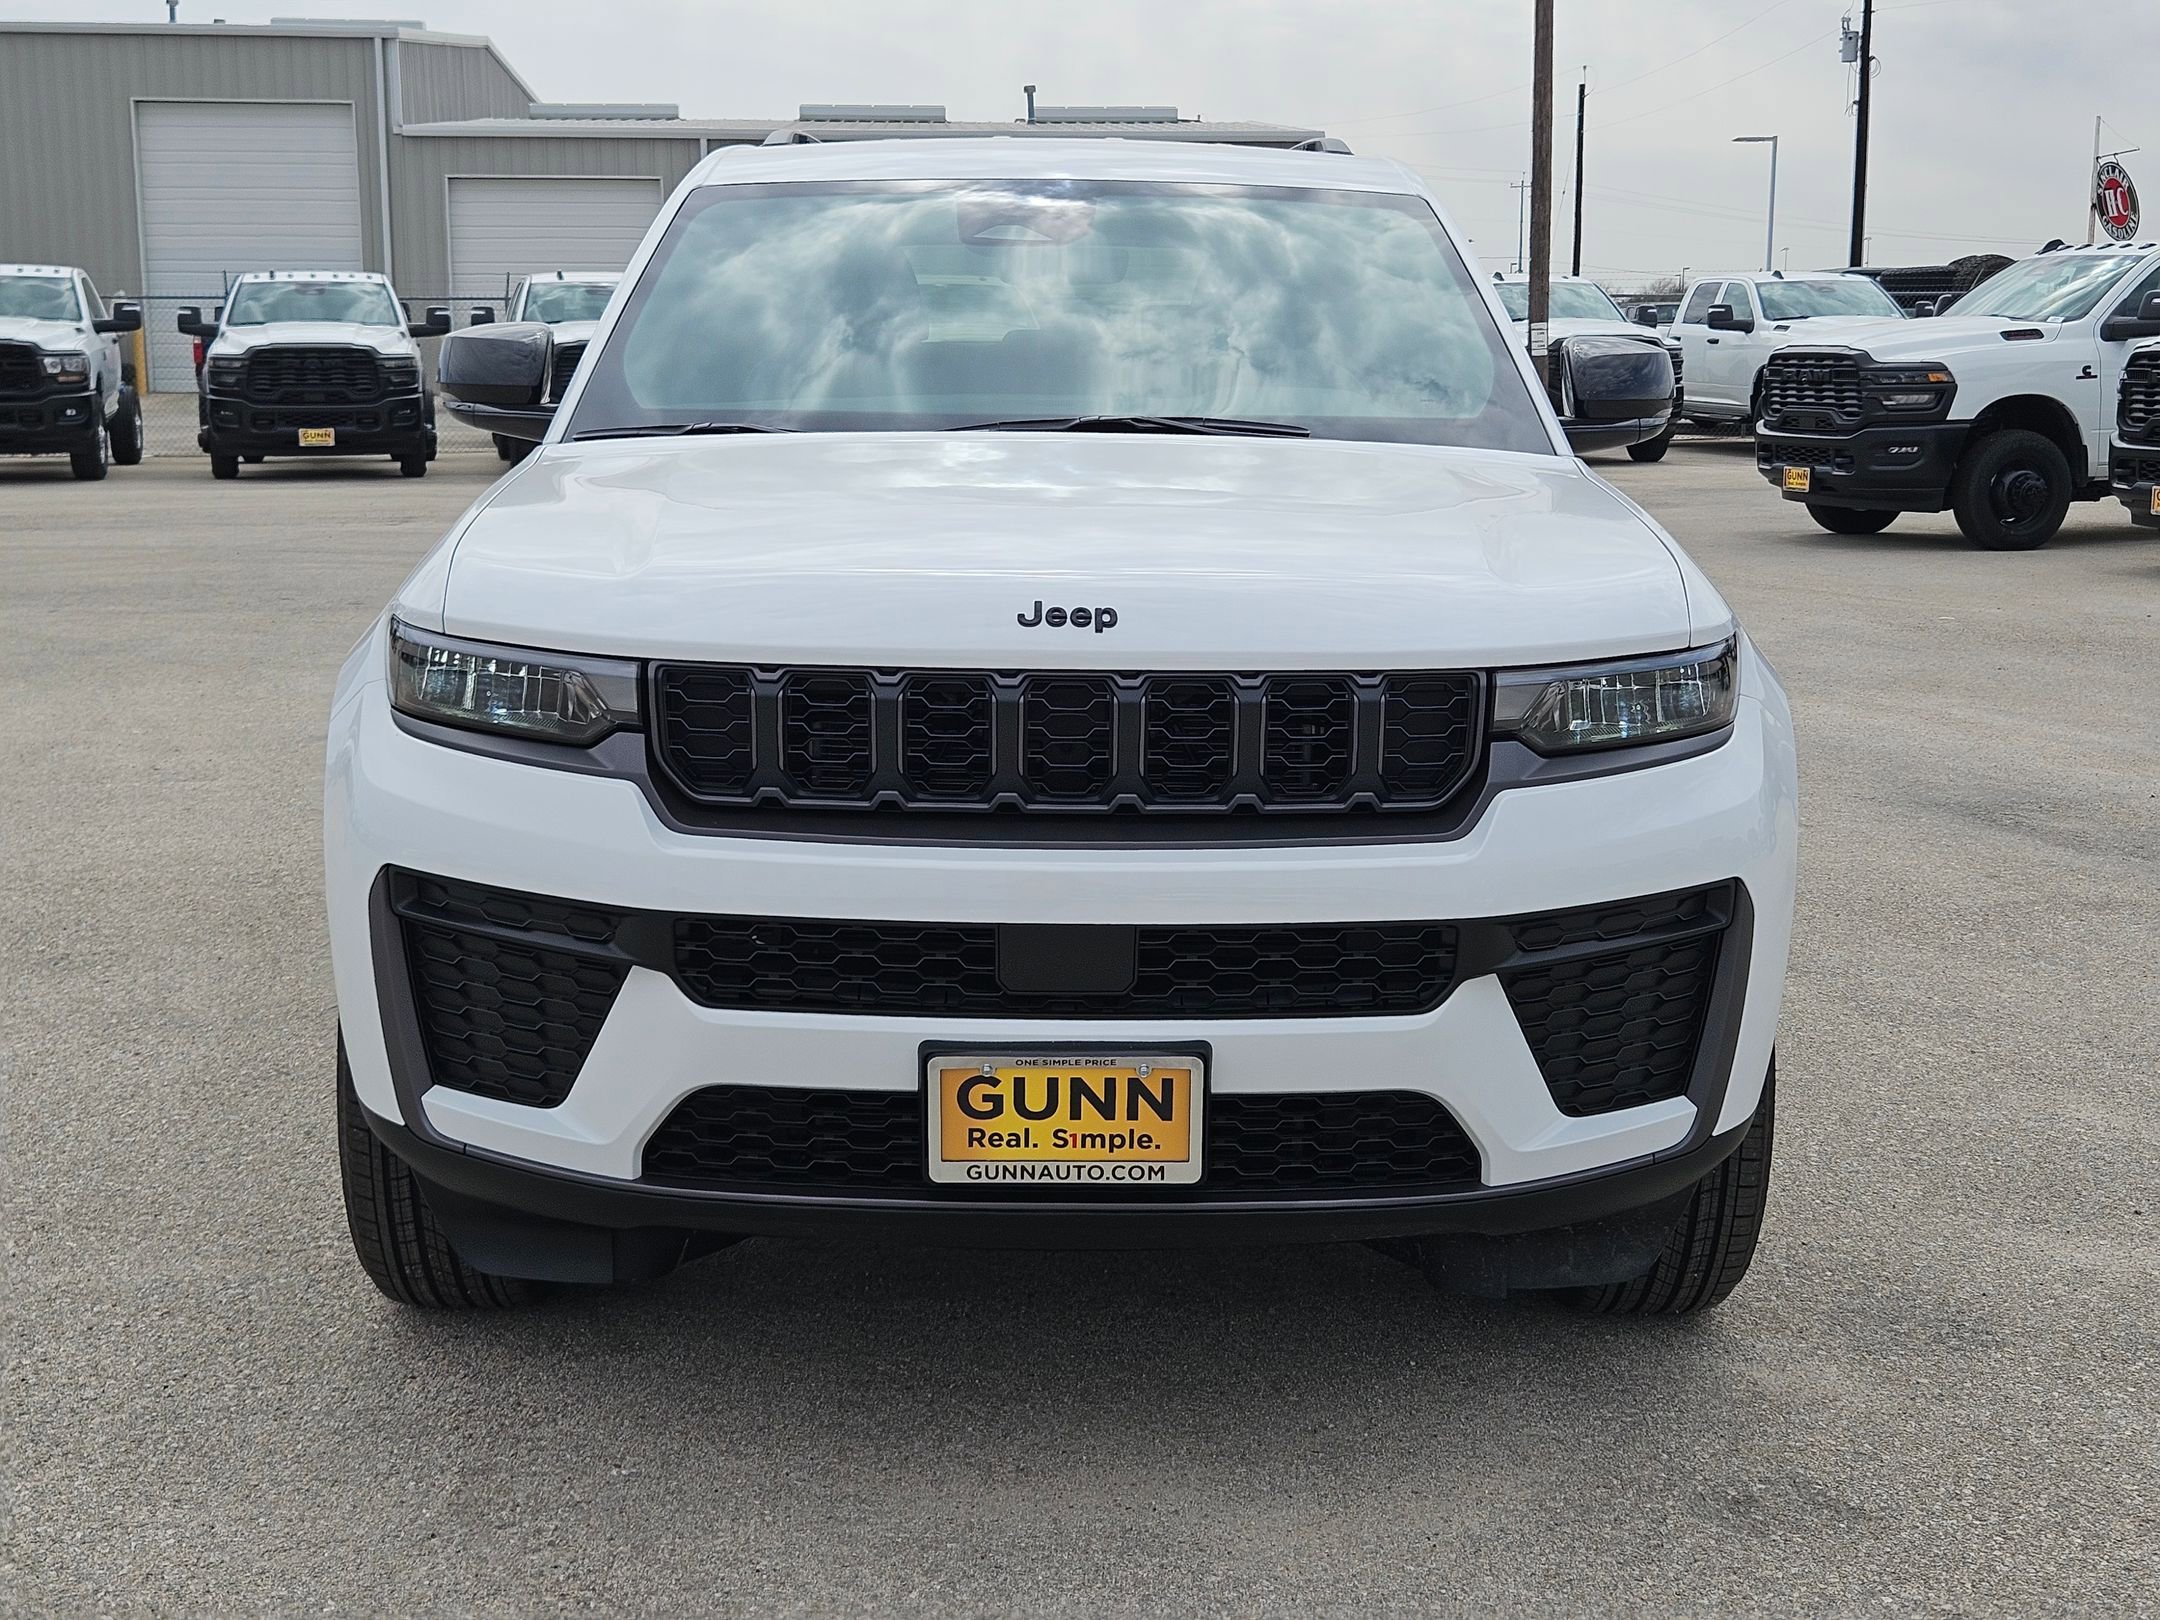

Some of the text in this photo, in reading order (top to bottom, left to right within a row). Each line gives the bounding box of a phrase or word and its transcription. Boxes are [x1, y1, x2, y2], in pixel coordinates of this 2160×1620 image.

[2097, 166, 2130, 196] SINCLAIR
[2102, 211, 2138, 239] GASOLINE
[1787, 471, 1808, 480] GUNN
[1017, 600, 1118, 633] Jeep
[956, 1074, 1174, 1121] GUNN
[967, 1127, 1039, 1149] Real.
[966, 1164, 1165, 1181] GUNNAUTO.COM
